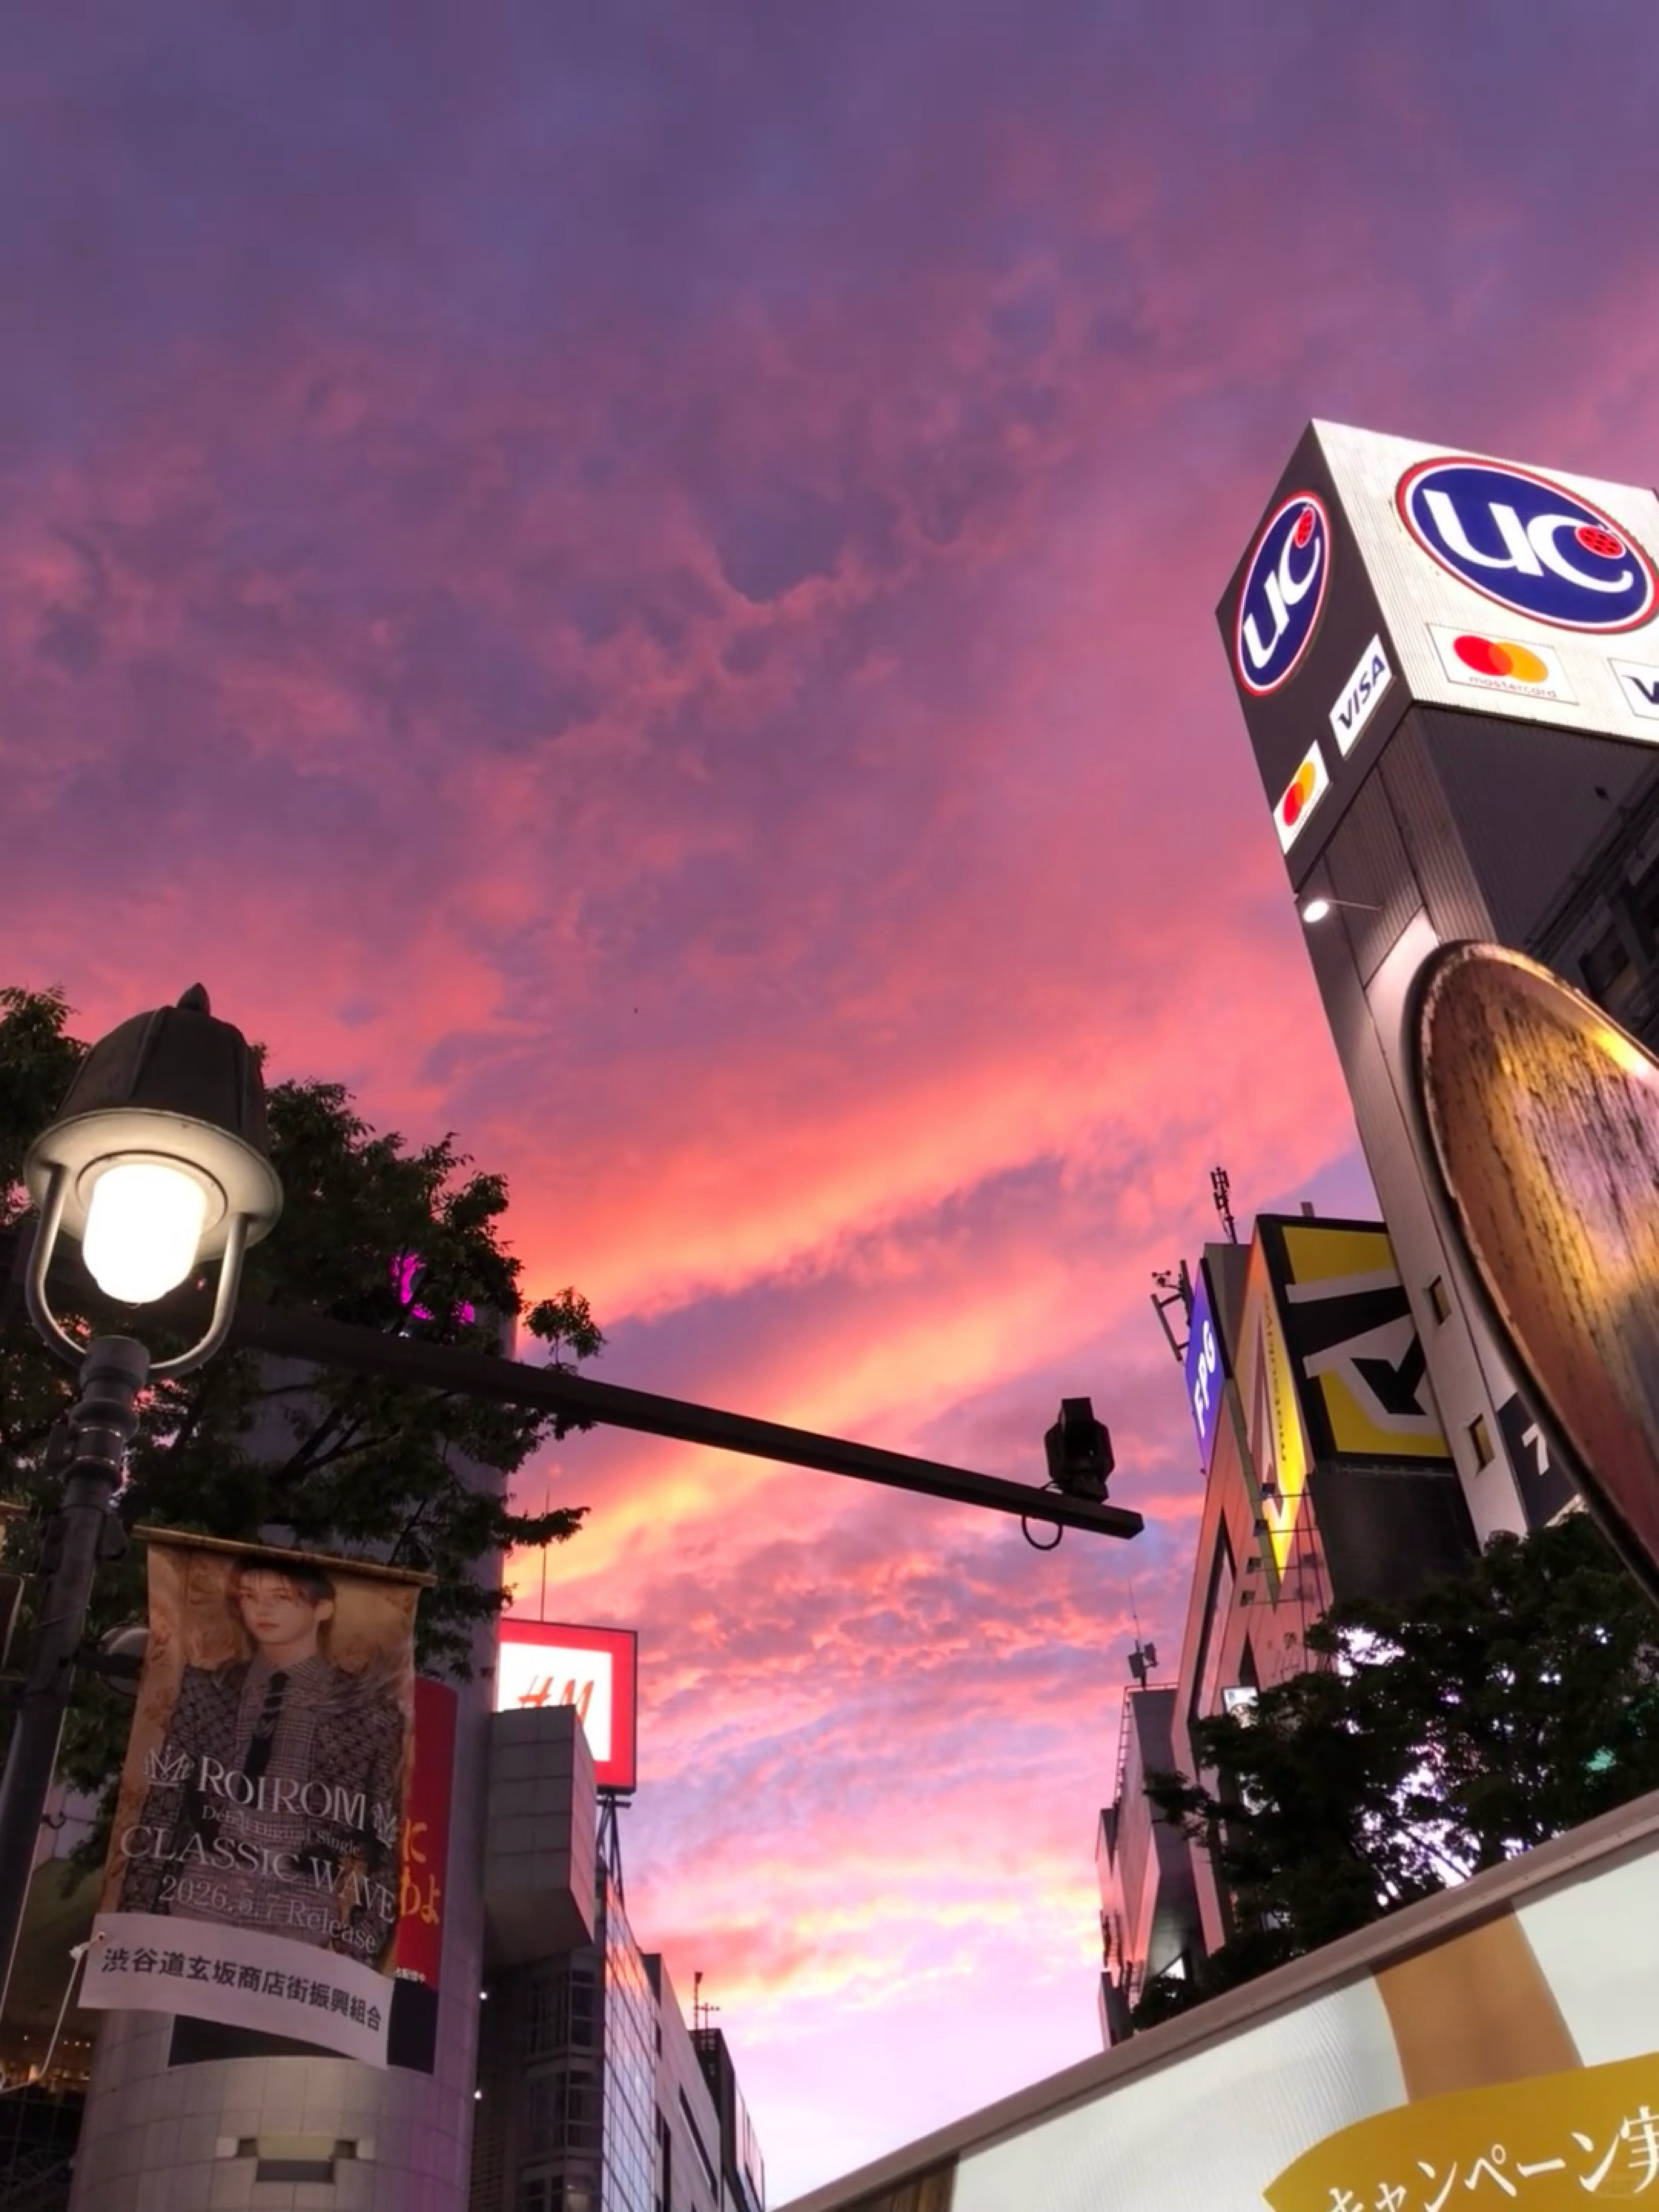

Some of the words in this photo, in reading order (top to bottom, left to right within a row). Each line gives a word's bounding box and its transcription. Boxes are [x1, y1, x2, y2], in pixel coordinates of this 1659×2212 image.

[1336, 654, 1386, 731] VISA
[1195, 1319, 1216, 1438] FPG
[198, 1756, 366, 1830] ROIROM
[121, 1825, 299, 1882] CLASSIC
[310, 1857, 395, 1923] WAVE
[286, 1900, 376, 1951] Release
[102, 1947, 381, 2031] 渋谷道玄坂商店街振興組合
